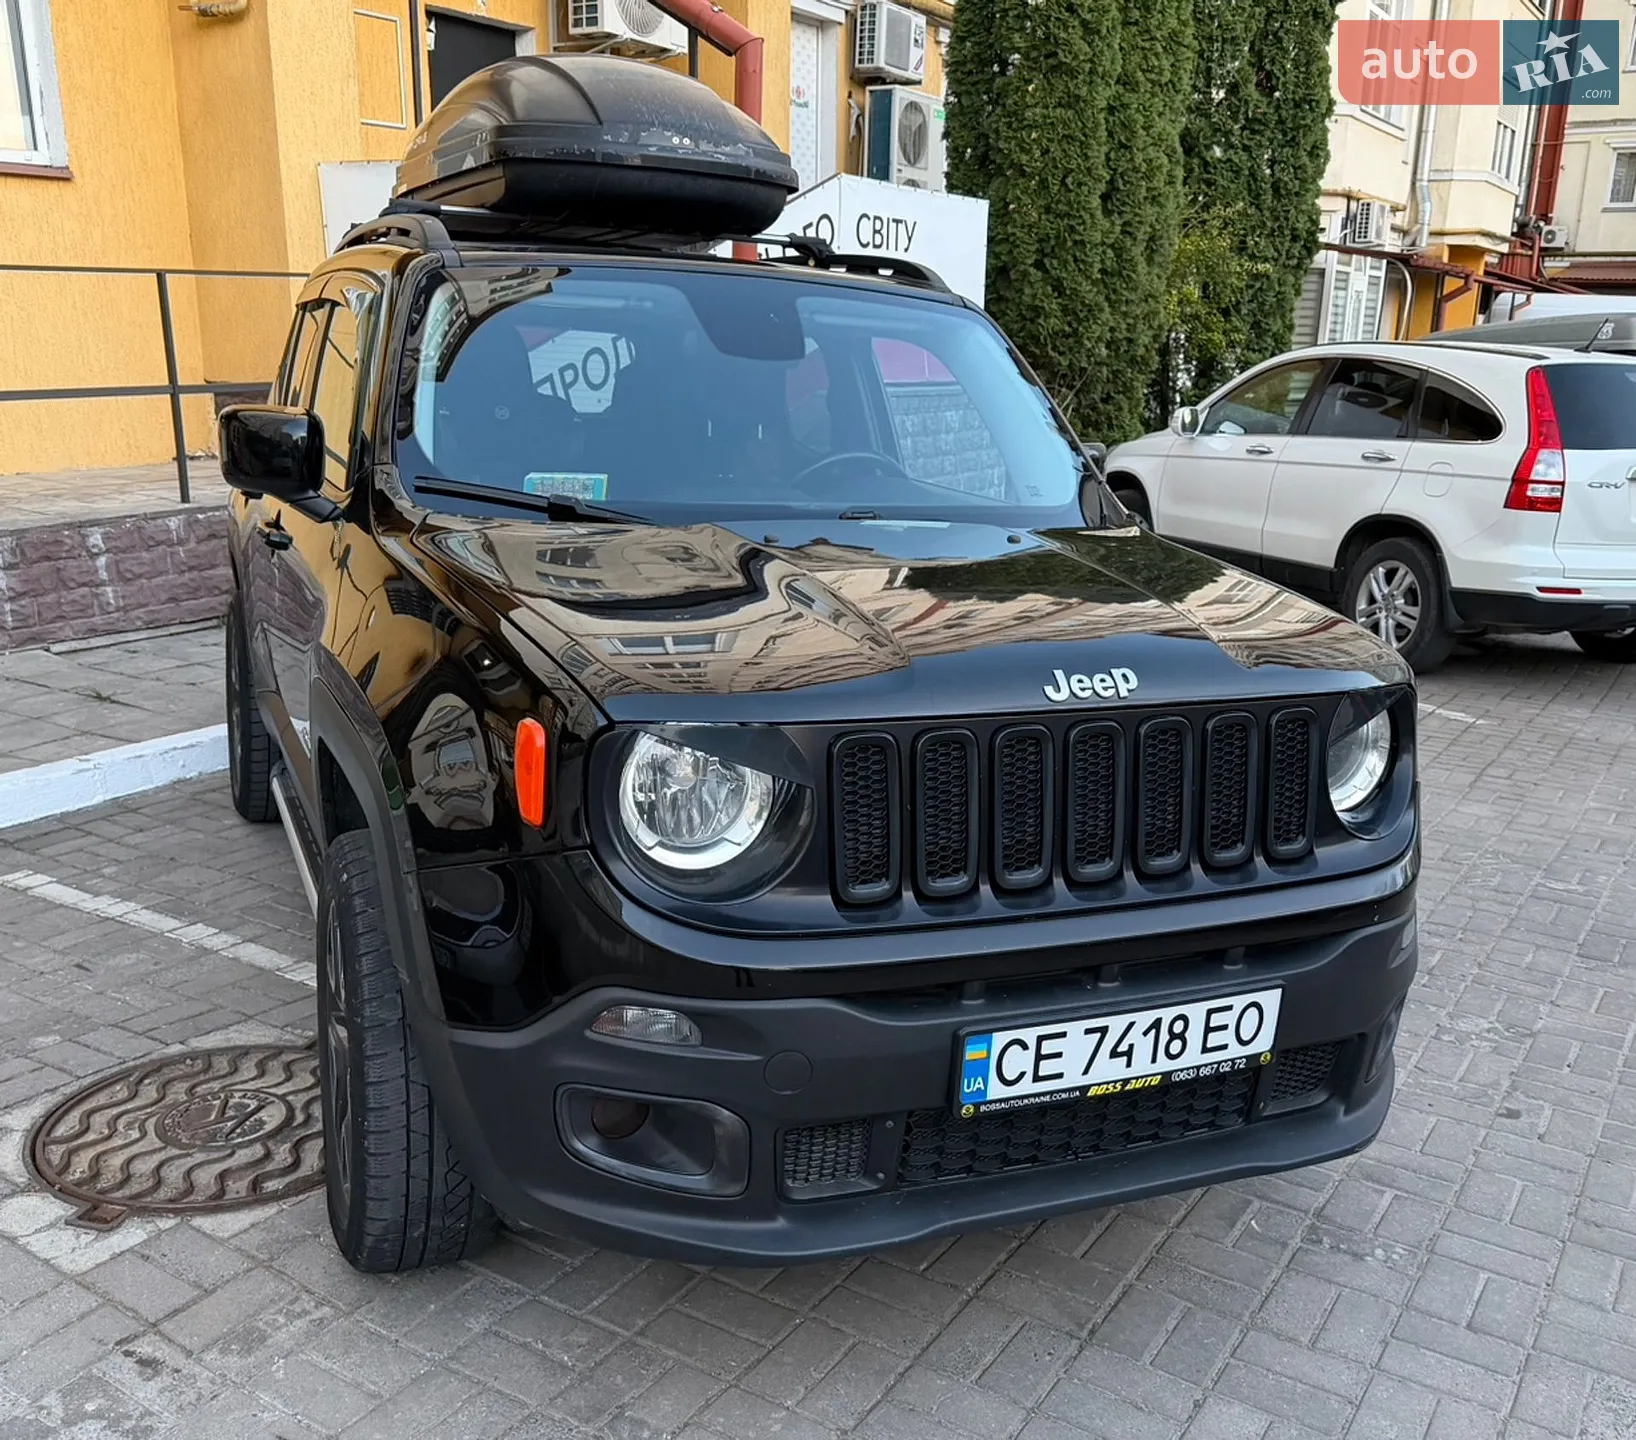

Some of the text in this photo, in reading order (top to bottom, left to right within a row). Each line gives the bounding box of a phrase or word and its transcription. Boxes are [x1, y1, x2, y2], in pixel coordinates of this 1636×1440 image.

[856, 212, 917, 253] СВІТУ
[1043, 667, 1139, 702] Jeep
[995, 1001, 1264, 1087] CE 7418 EO
[963, 1077, 985, 1092] UA
[980, 1058, 1247, 1112] BOSSAUTOUKRAINE.COM.UA BOSS AUTO (063) 667 02 72
